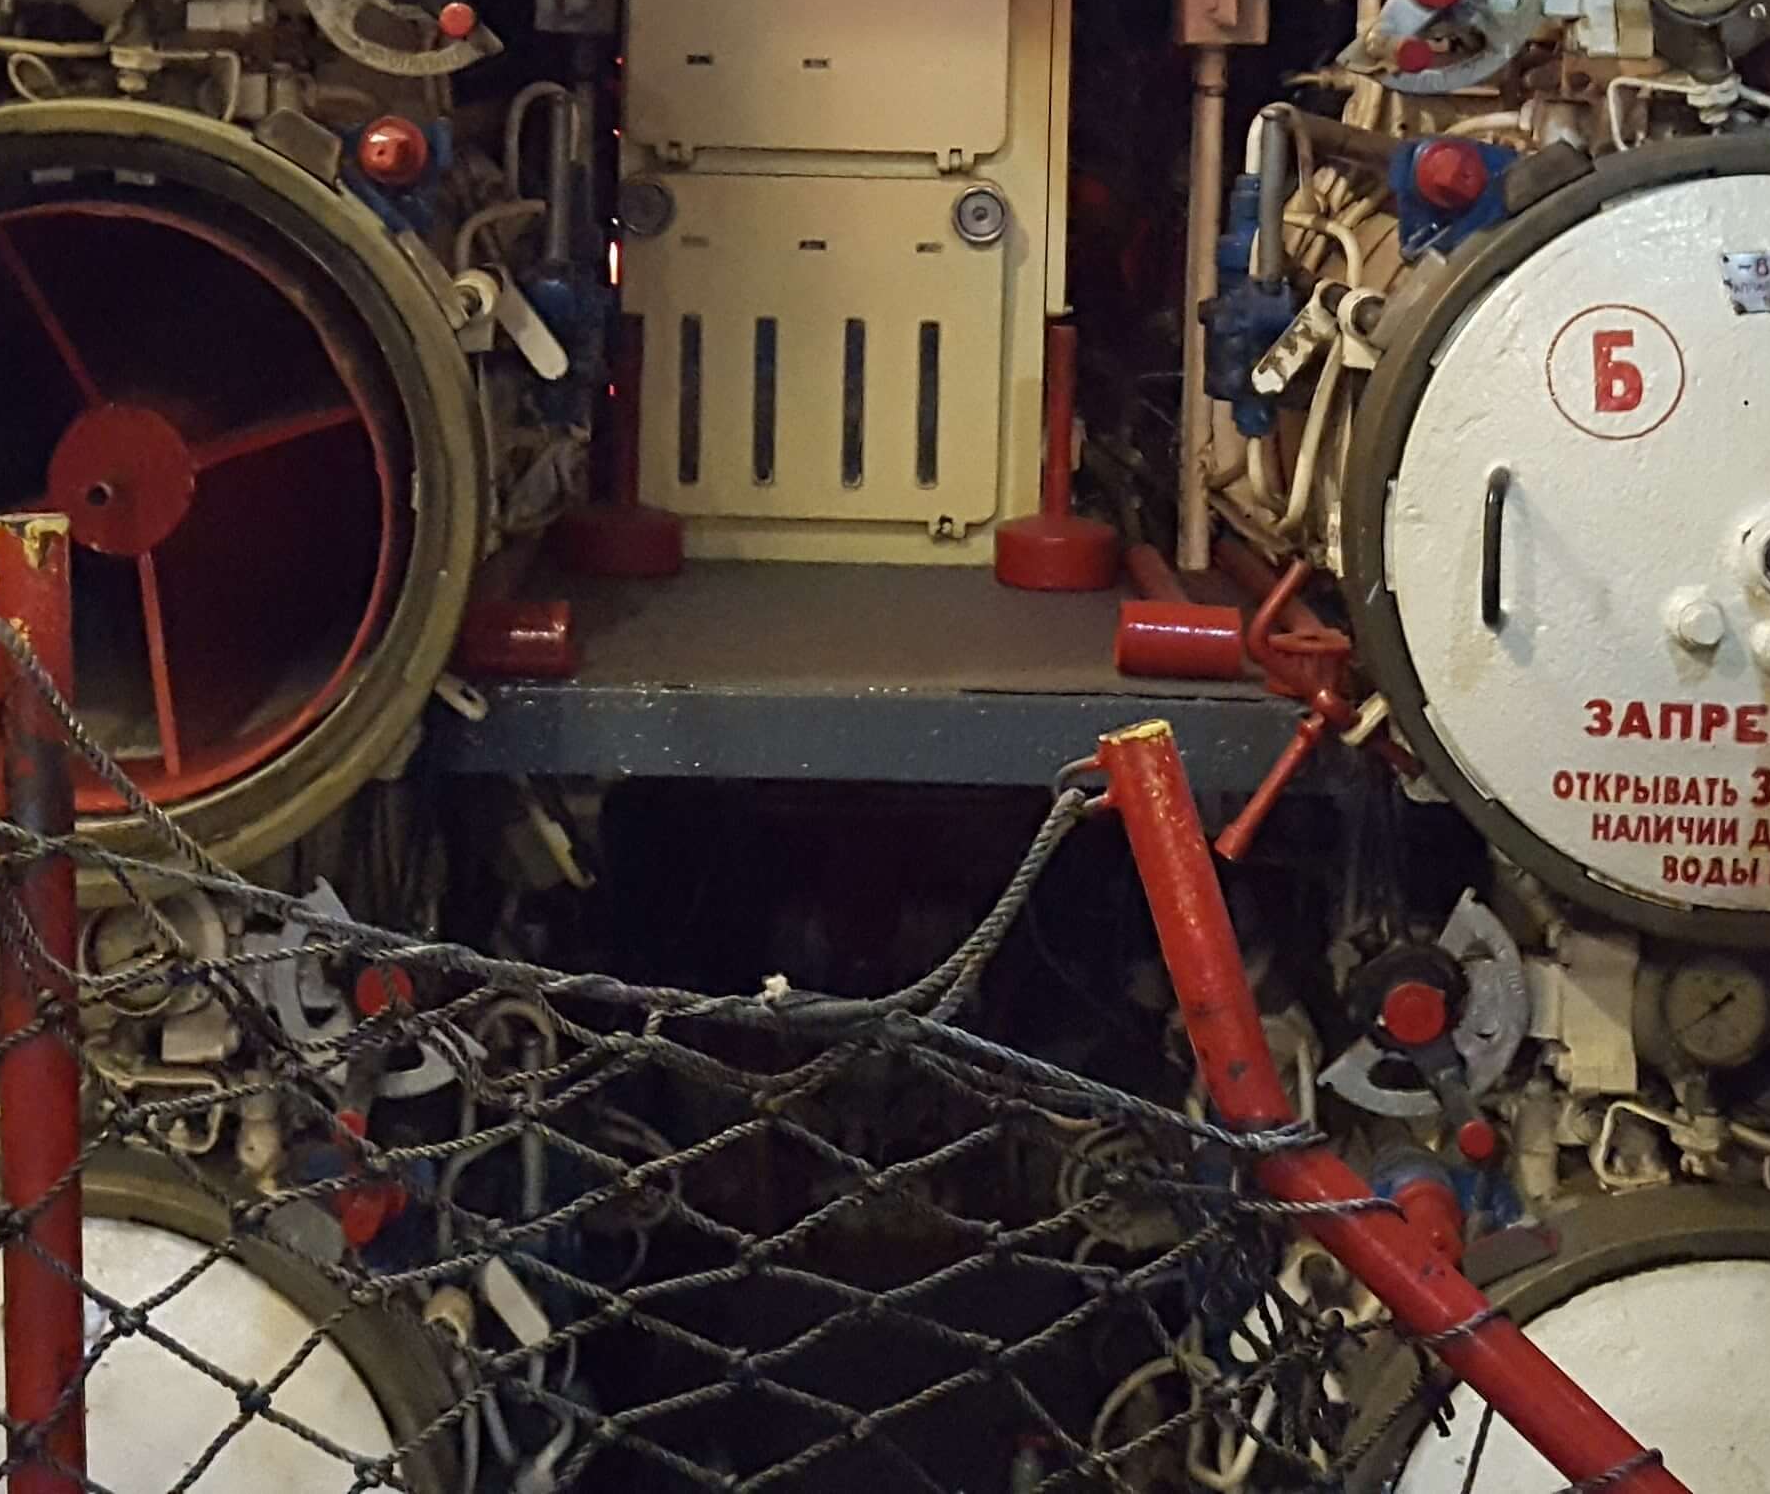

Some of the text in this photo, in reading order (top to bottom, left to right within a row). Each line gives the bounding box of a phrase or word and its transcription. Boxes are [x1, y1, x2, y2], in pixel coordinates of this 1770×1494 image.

[1591, 330, 1644, 413] Б
[1552, 769, 1738, 807] ОТКРЫВАТЬ
[1591, 813, 1739, 845] НАЛИЧИИ
[1661, 855, 1759, 888] ВОДЫ
